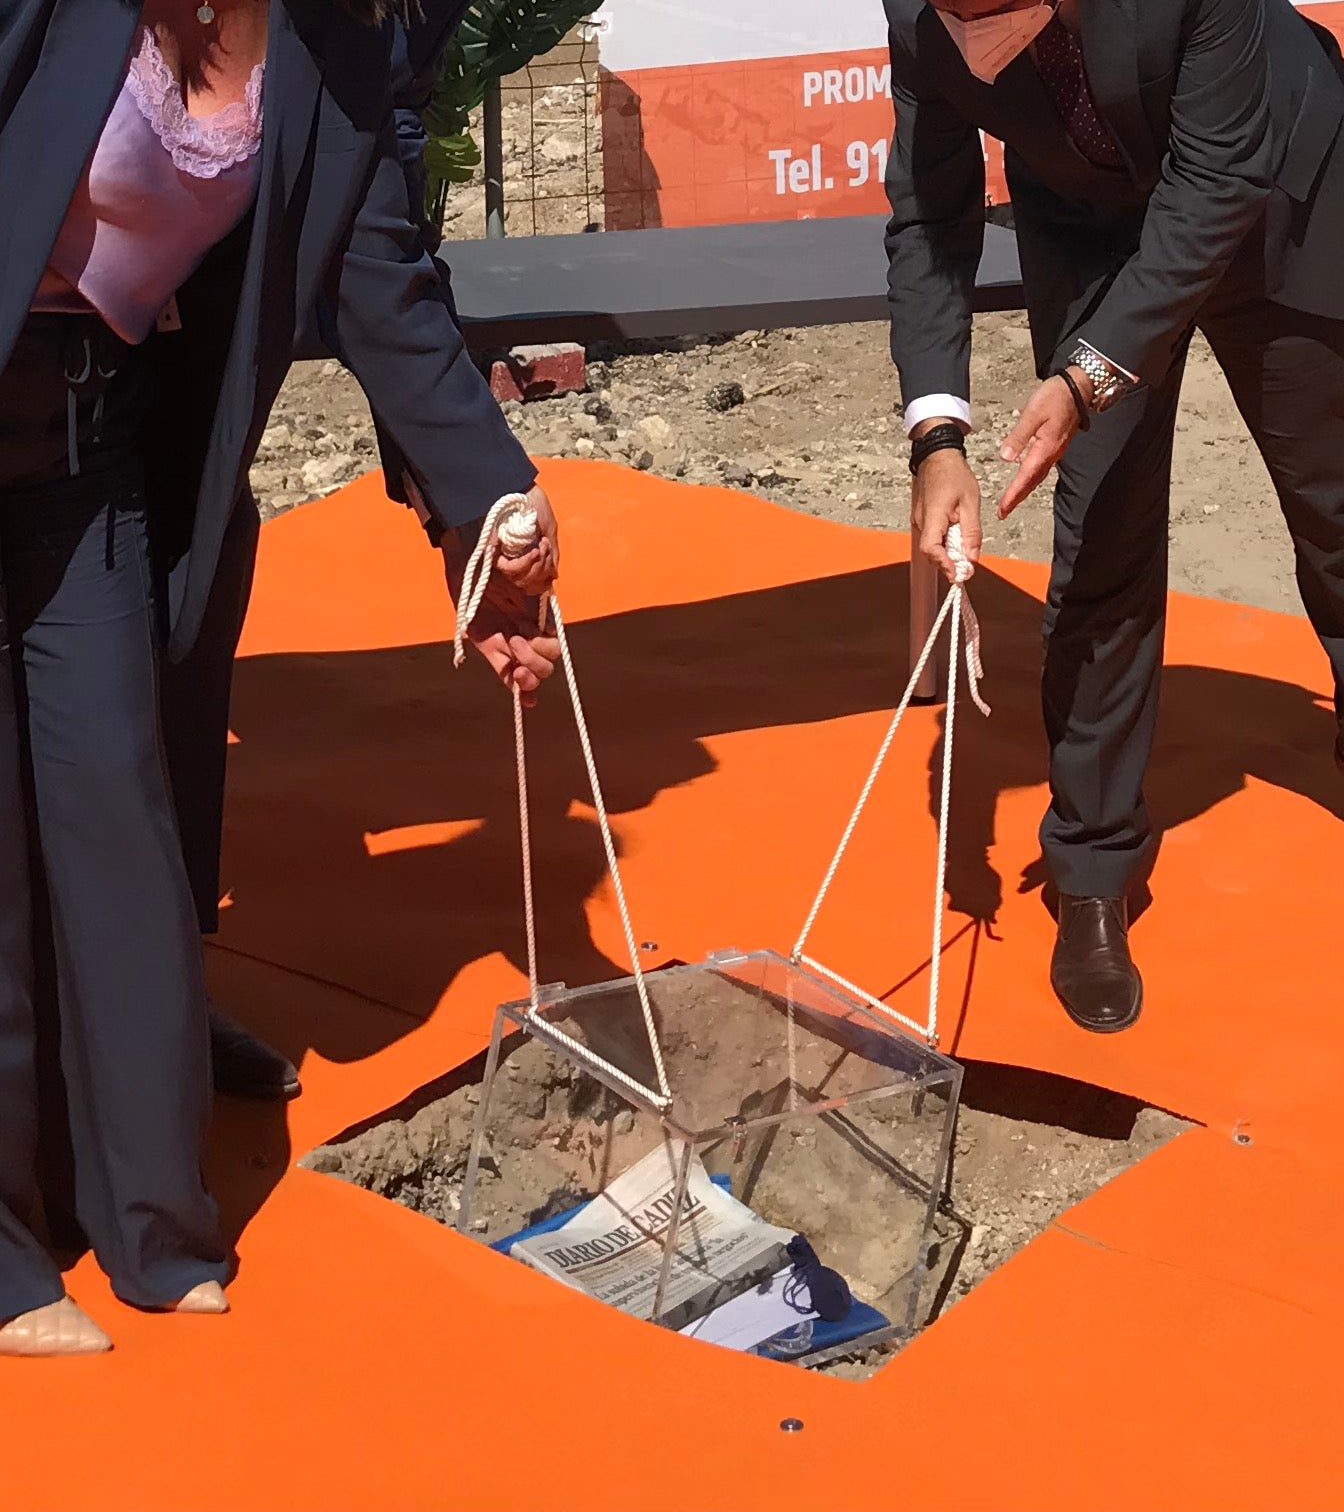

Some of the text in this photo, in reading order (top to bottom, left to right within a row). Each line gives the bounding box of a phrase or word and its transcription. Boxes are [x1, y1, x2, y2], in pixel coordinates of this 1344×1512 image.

[803, 63, 893, 107] PROM
[768, 143, 834, 194] Tel.
[544, 1240, 616, 1268] DIARIO
[606, 1224, 642, 1249] DE
